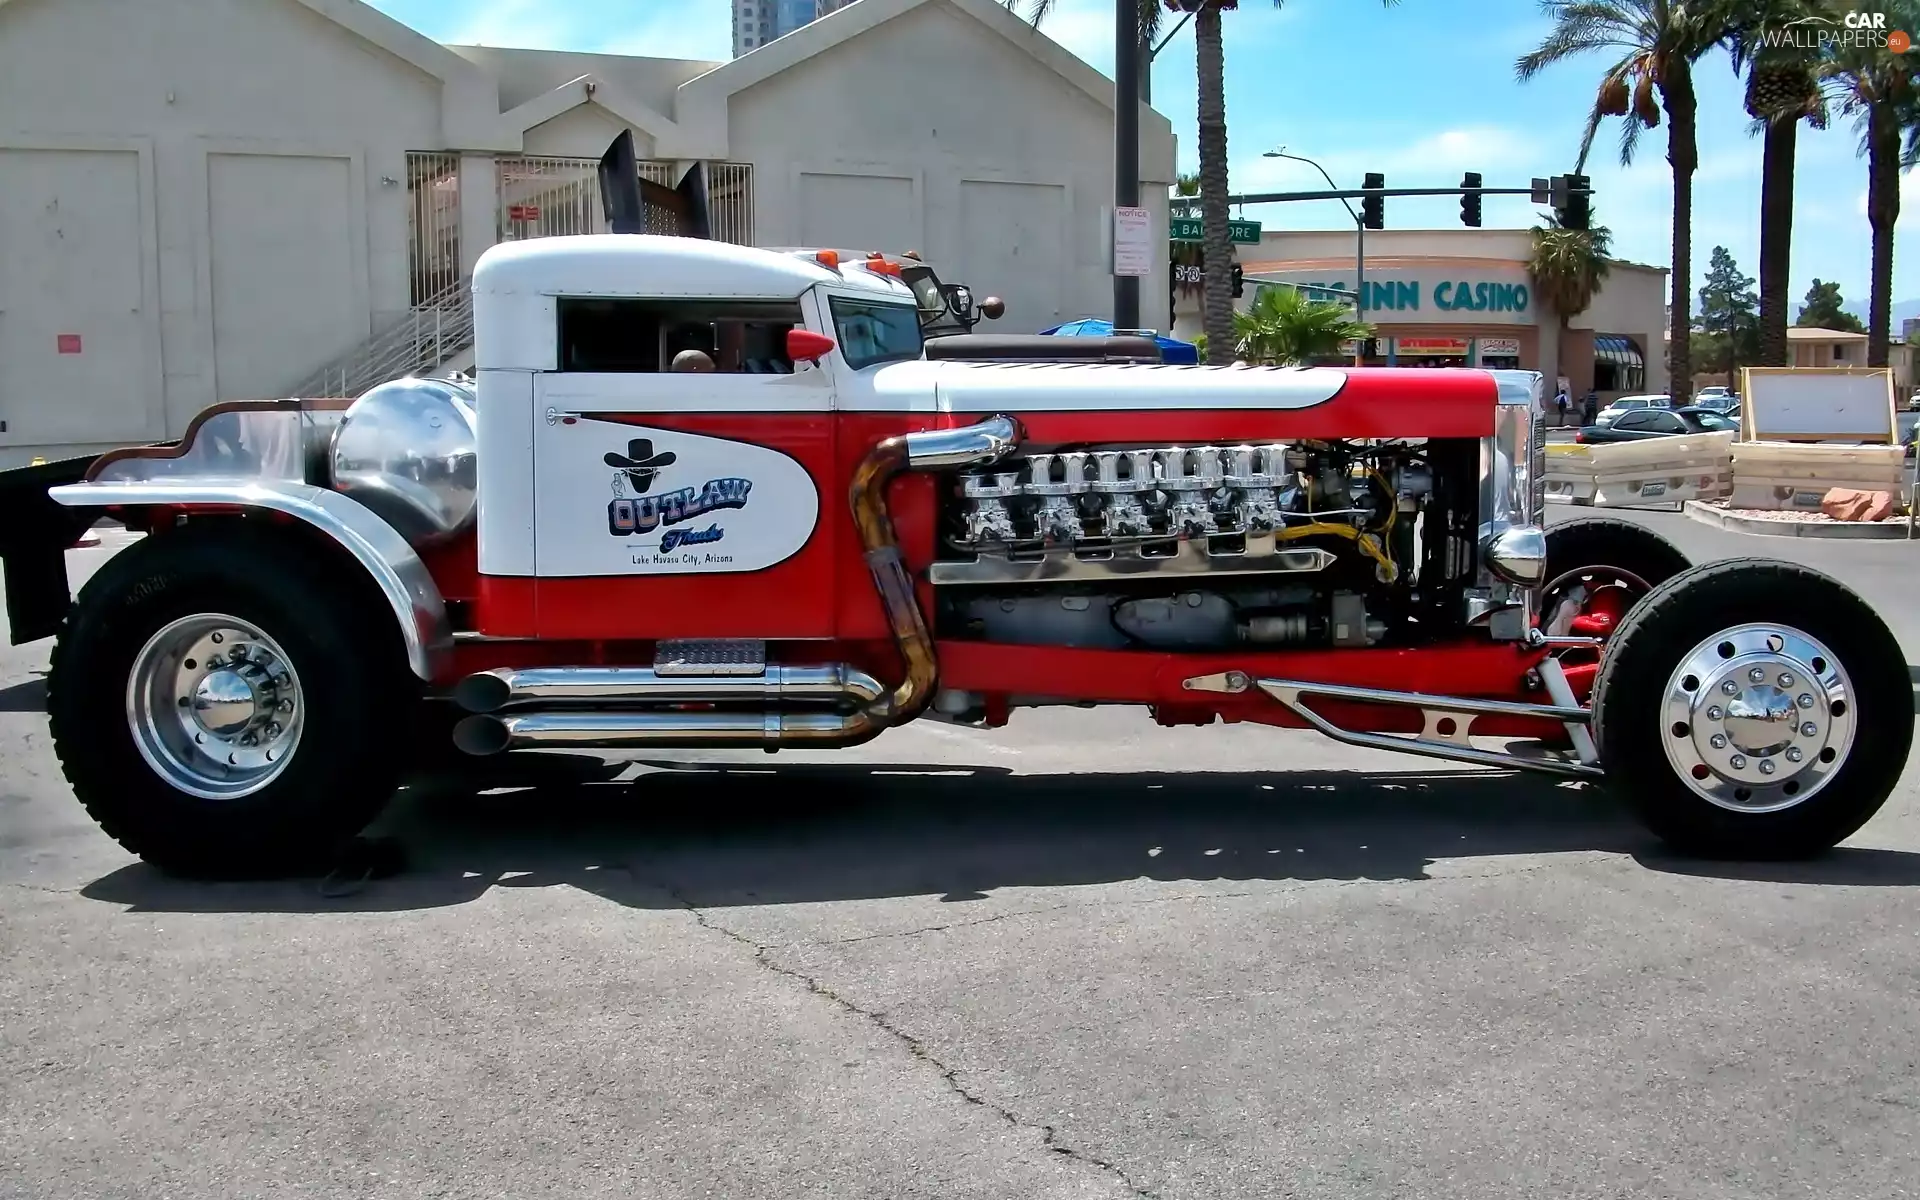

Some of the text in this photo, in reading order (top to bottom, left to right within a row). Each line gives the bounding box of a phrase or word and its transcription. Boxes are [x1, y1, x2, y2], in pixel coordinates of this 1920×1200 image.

[1118, 210, 1148, 218] NOTICE
[1182, 224, 1251, 238] BALORE
[1360, 281, 1419, 311] INN
[1433, 281, 1528, 312] CASINO
[608, 477, 753, 536] OUTLAW
[632, 553, 733, 566] Lake Havasu City, Arizona
